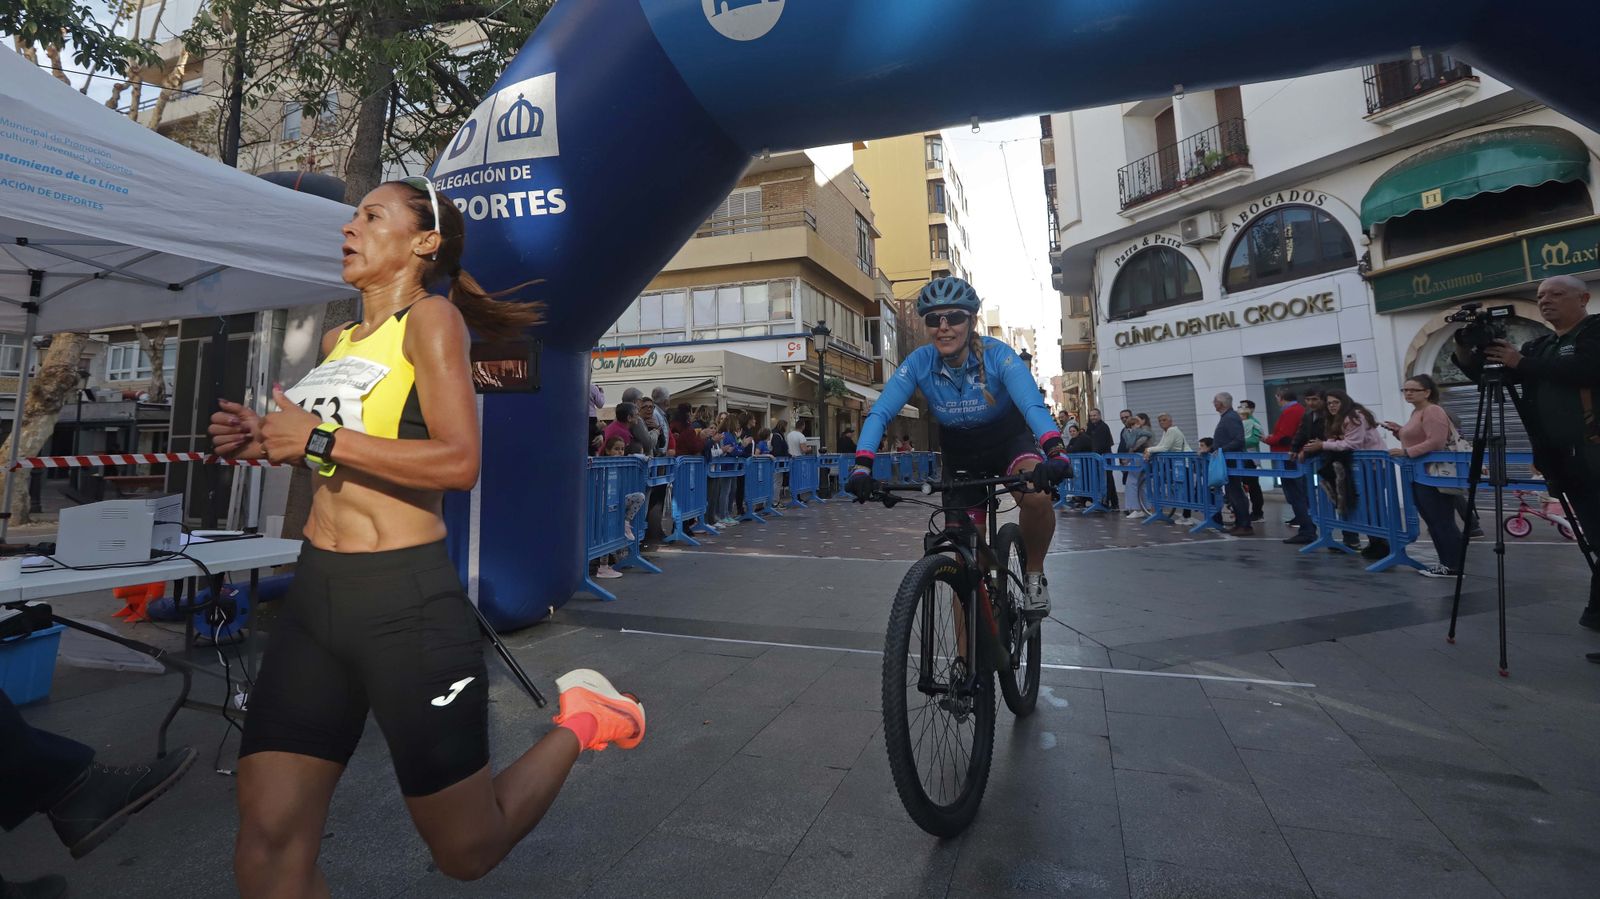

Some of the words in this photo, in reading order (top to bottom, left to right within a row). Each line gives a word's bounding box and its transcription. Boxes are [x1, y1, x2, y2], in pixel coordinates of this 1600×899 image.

[50, 134, 62, 145] de
[65, 170, 80, 181] de
[82, 175, 97, 185] La
[98, 180, 129, 195] Línea
[510, 165, 532, 181] DE
[37, 187, 52, 197] DE
[54, 191, 104, 210] DEPORTES
[453, 188, 567, 221] PORTES
[1231, 190, 1328, 232] ABOGADOS
[1114, 244, 1139, 267] Parra
[1142, 236, 1150, 247] &
[1155, 234, 1182, 249] Parra
[1115, 324, 1173, 348] CLÍNICA
[1176, 310, 1240, 337] DENTAL
[1243, 291, 1335, 325] CROOKE
[664, 352, 696, 365] Plaza
[297, 396, 343, 427] 53
